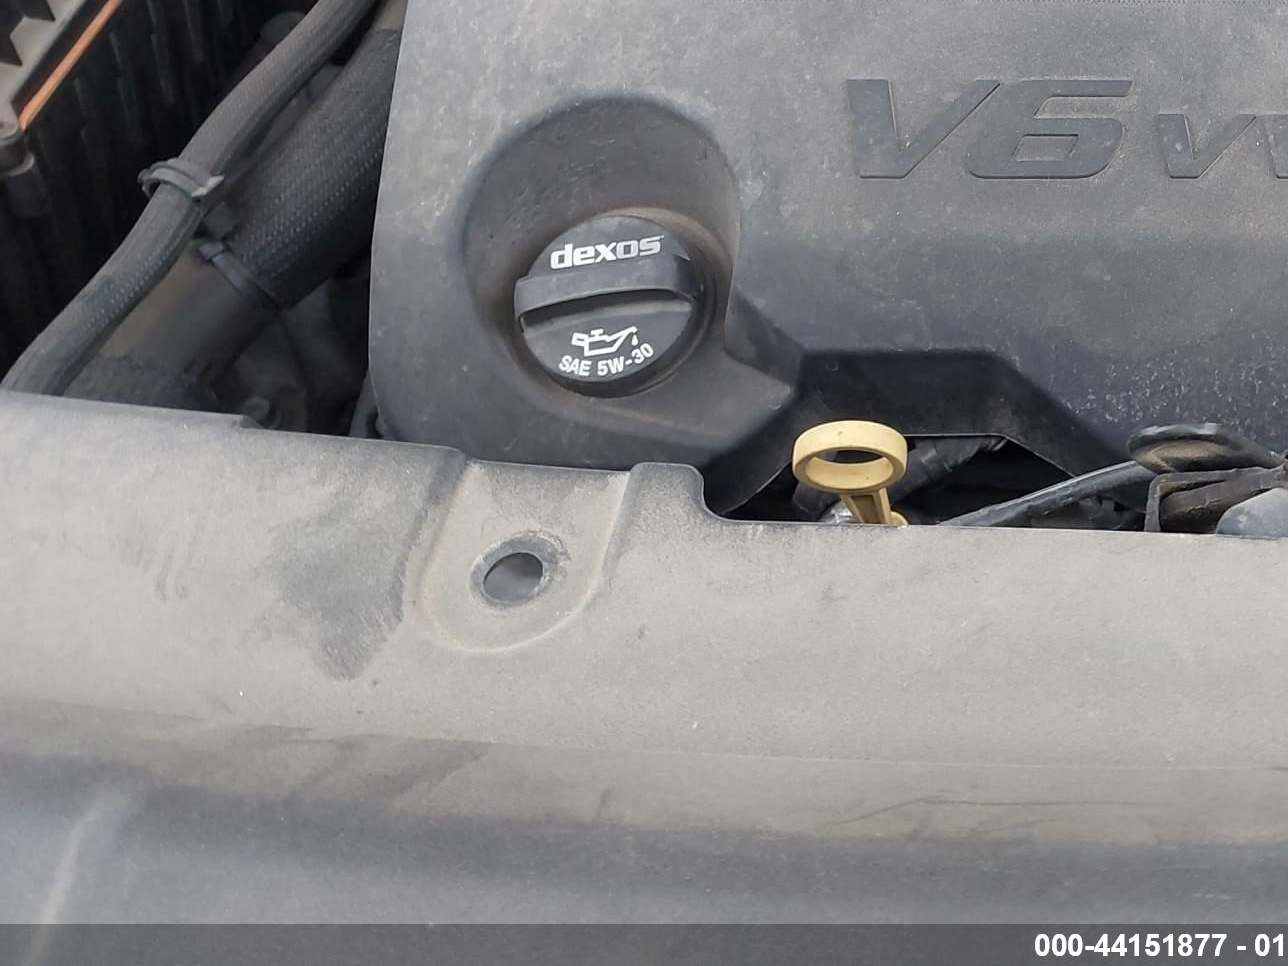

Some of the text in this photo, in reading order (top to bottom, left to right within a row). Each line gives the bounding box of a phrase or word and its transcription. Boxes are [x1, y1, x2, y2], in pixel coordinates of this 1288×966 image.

[846, 78, 1136, 179] V6
[550, 235, 664, 270] dexos
[558, 342, 655, 376] SAE 5W-30
